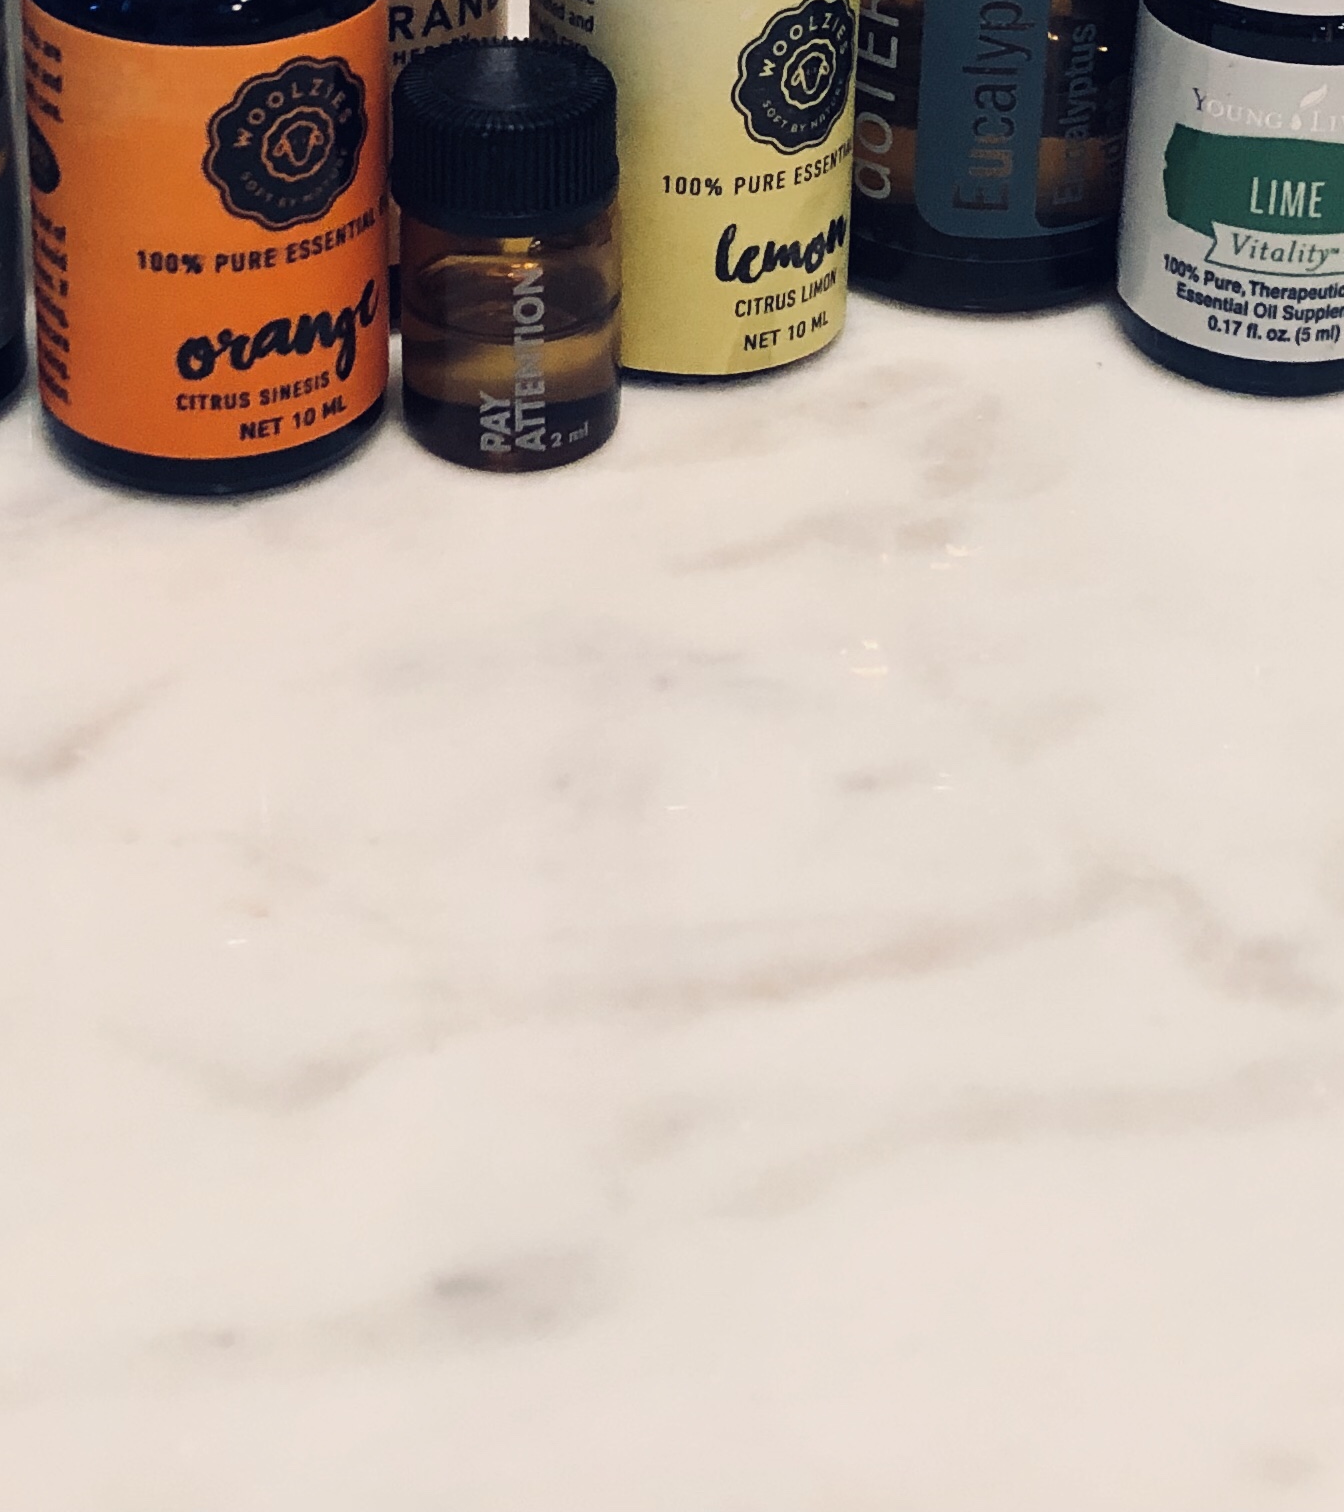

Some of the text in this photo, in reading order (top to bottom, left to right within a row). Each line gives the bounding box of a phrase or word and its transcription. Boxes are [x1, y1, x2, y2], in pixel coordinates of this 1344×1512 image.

[568, 11, 594, 33] and
[758, 12, 848, 78] WOOLZIES
[233, 77, 353, 148] WOOLZIES
[762, 99, 788, 129] SOFT
[790, 122, 807, 134] BY
[1193, 88, 1282, 130] YOUNG
[662, 138, 853, 196] 100% PURE ESSENTIA
[1249, 176, 1326, 219] LIME
[137, 206, 377, 275] 100% PURE ESSENTIAL
[715, 214, 846, 284] lemon
[735, 267, 838, 318] CITRUS LIMON
[1163, 254, 1200, 284] 100%
[1203, 271, 1246, 297] Pure,
[1176, 283, 1249, 317] Essential
[1254, 301, 1278, 320] Oil
[176, 278, 379, 381] orange
[744, 311, 829, 352] NET 10 ML
[1207, 315, 1341, 346] 0.17 fl. oz. (5 ml)
[513, 267, 547, 453] ATTENTION
[176, 371, 331, 413] CITRUS SINESIS
[240, 395, 349, 442] NET 10 ML
[479, 390, 511, 453] PAY
[550, 431, 563, 449] 2
